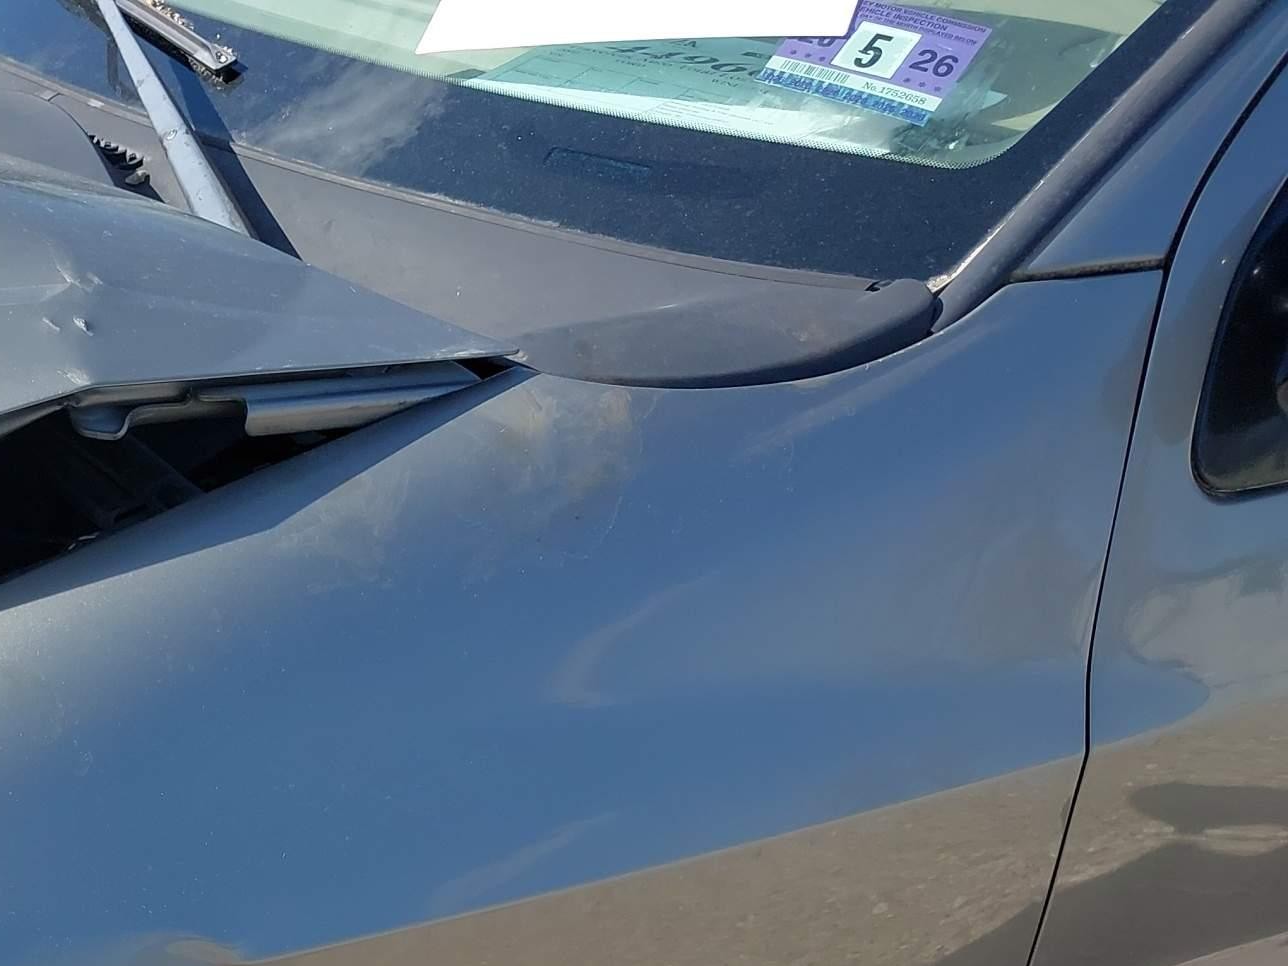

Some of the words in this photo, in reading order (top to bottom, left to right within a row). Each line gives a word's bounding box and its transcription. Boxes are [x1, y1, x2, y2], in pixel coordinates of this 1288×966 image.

[874, 2, 903, 14] MOTOR
[903, 9, 936, 21] VEHICLE
[936, 16, 987, 33] COMMISSION
[893, 12, 948, 31] INSPECTION
[853, 33, 894, 69] 5
[909, 49, 959, 78] 26
